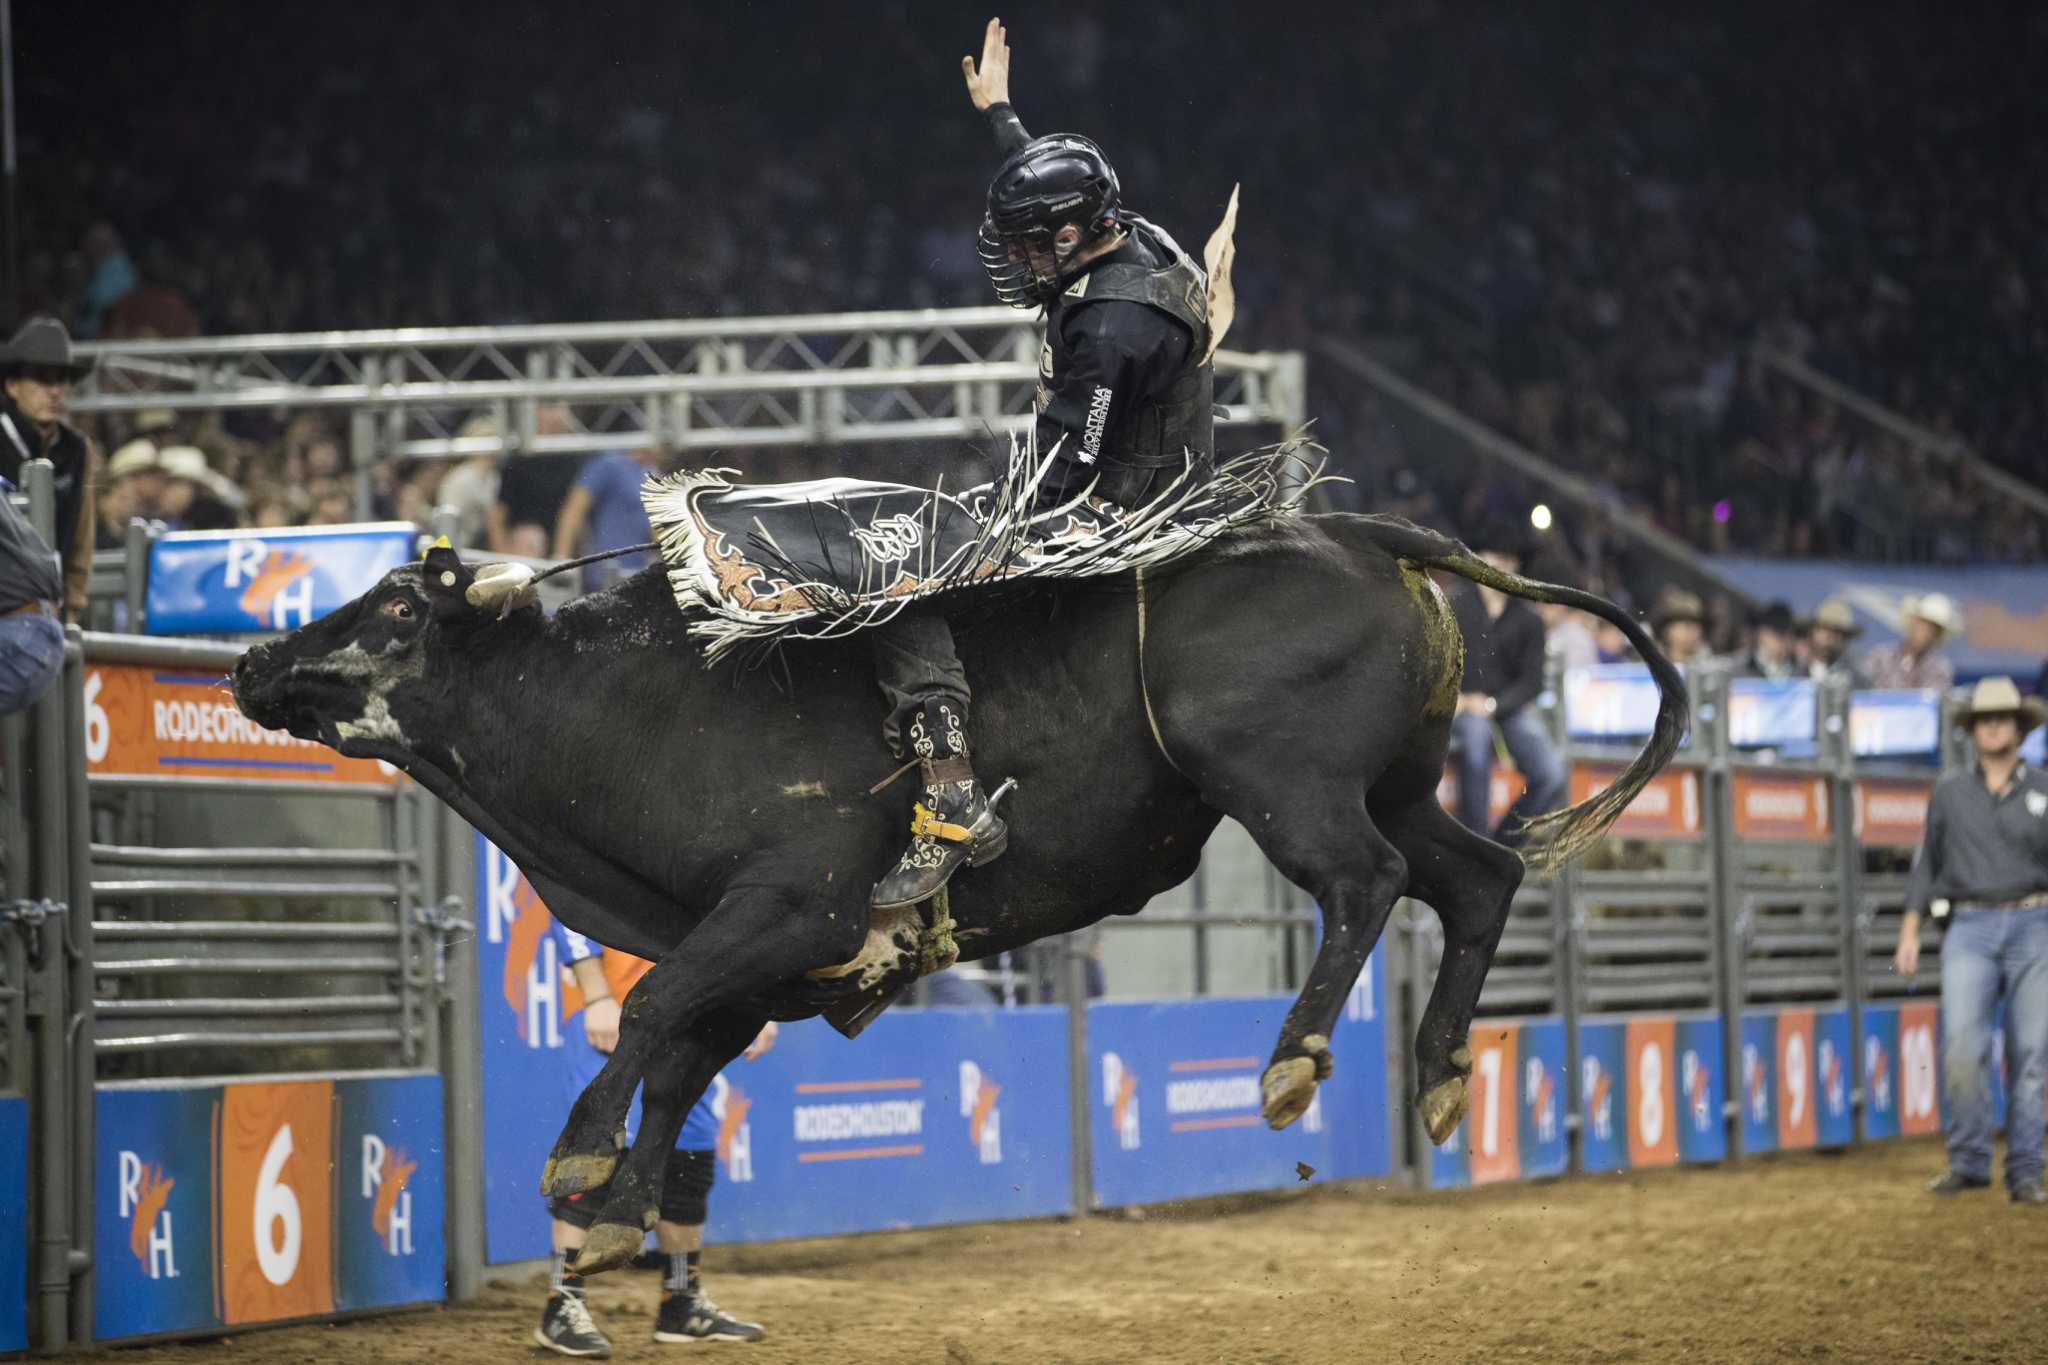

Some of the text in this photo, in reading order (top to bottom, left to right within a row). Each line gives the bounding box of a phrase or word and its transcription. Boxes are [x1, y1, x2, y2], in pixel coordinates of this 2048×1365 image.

[1083, 387, 1108, 454] MONTANA
[84, 671, 109, 763] 6
[153, 700, 326, 748] RODEOHO
[1640, 1041, 1664, 1148] 8
[1786, 1030, 1806, 1131] 9
[119, 1151, 176, 1280] R H
[253, 1123, 302, 1287] 6
[362, 1134, 413, 1256] R H
